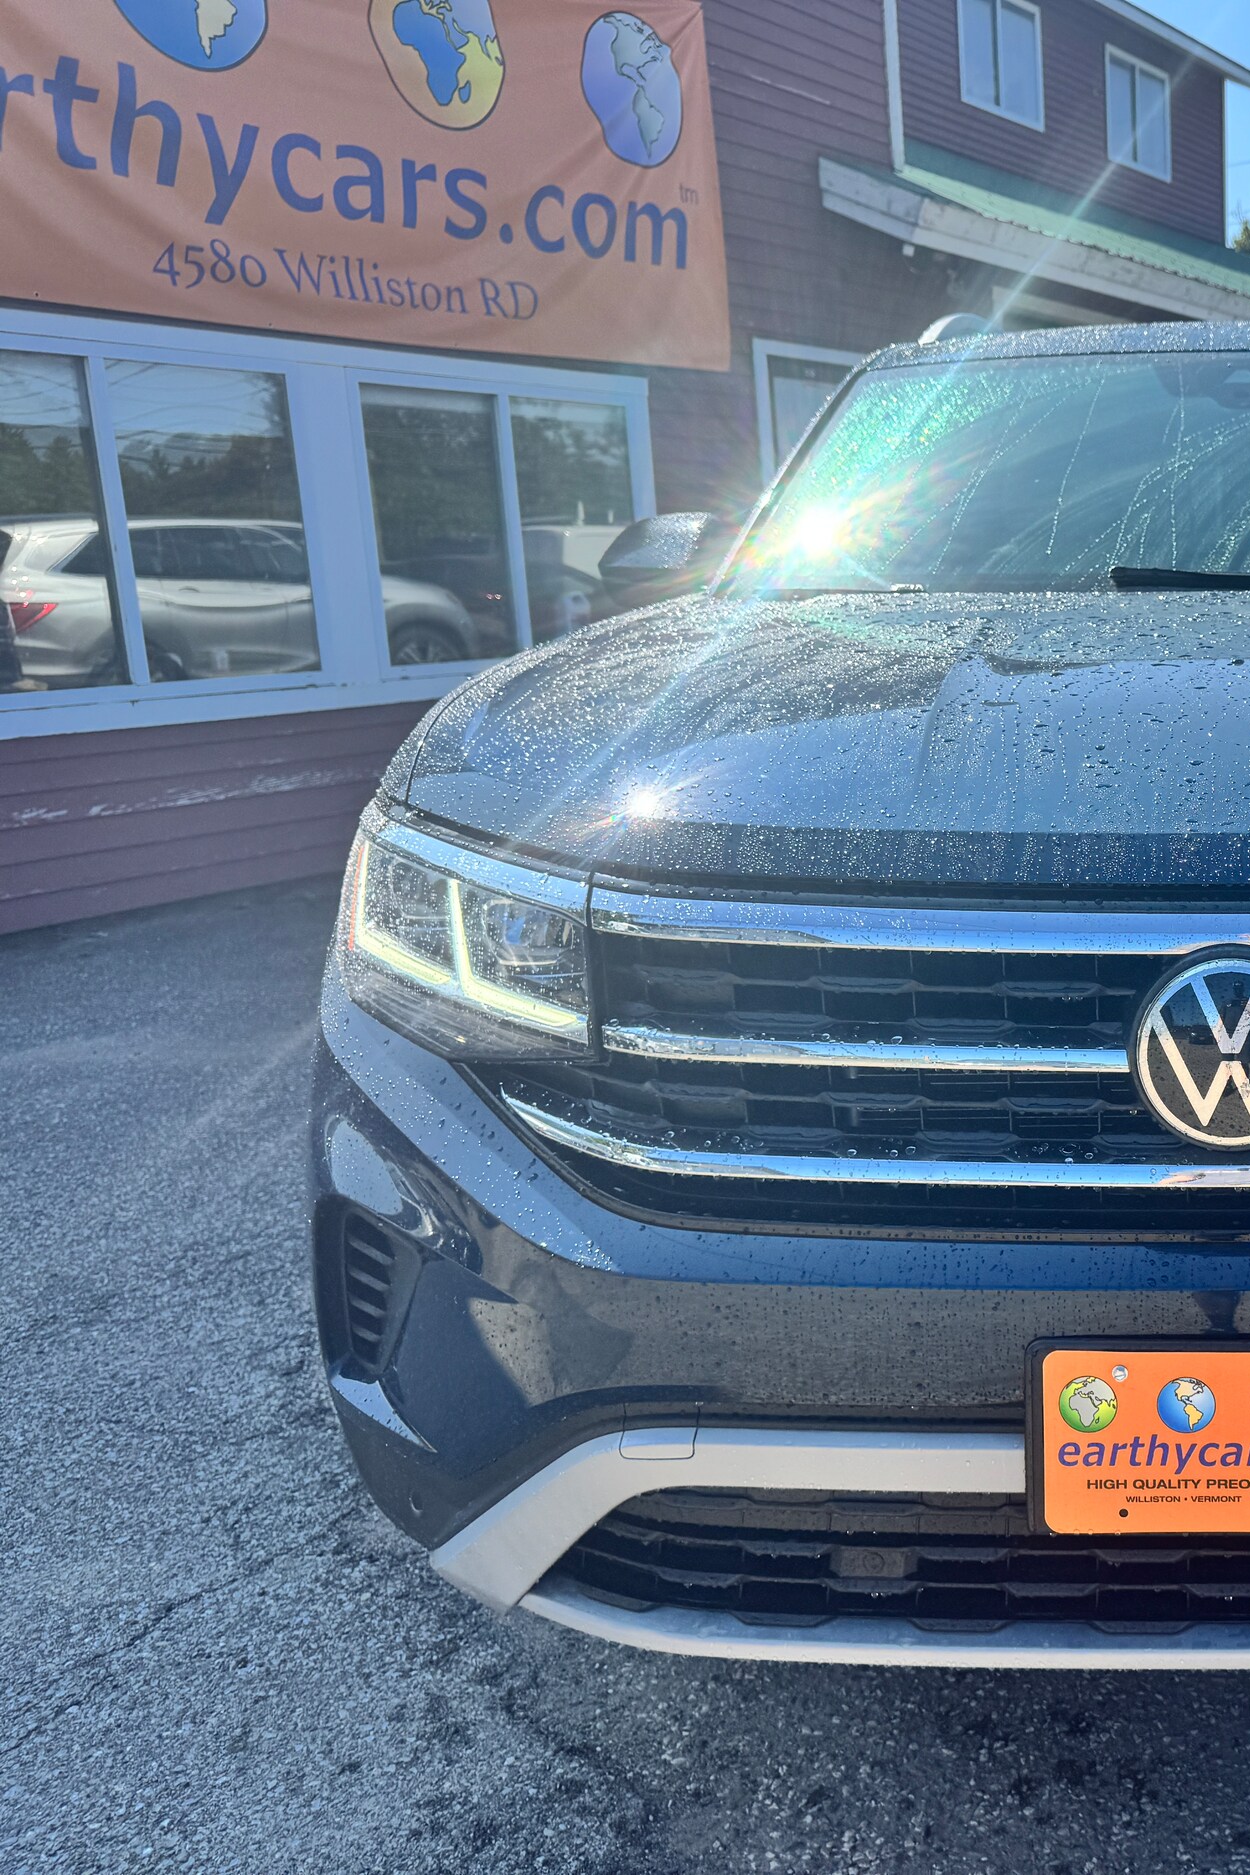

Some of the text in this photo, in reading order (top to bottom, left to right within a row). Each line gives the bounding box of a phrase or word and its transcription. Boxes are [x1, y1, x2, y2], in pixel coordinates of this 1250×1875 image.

[152, 238, 539, 321] 4580 Williston RD
[1086, 1478, 1128, 1490] HIGH
[1132, 1478, 1201, 1491] QUALITY
[1125, 1495, 1182, 1503] WILLISTON
[1190, 1495, 1242, 1503] VERMONT
